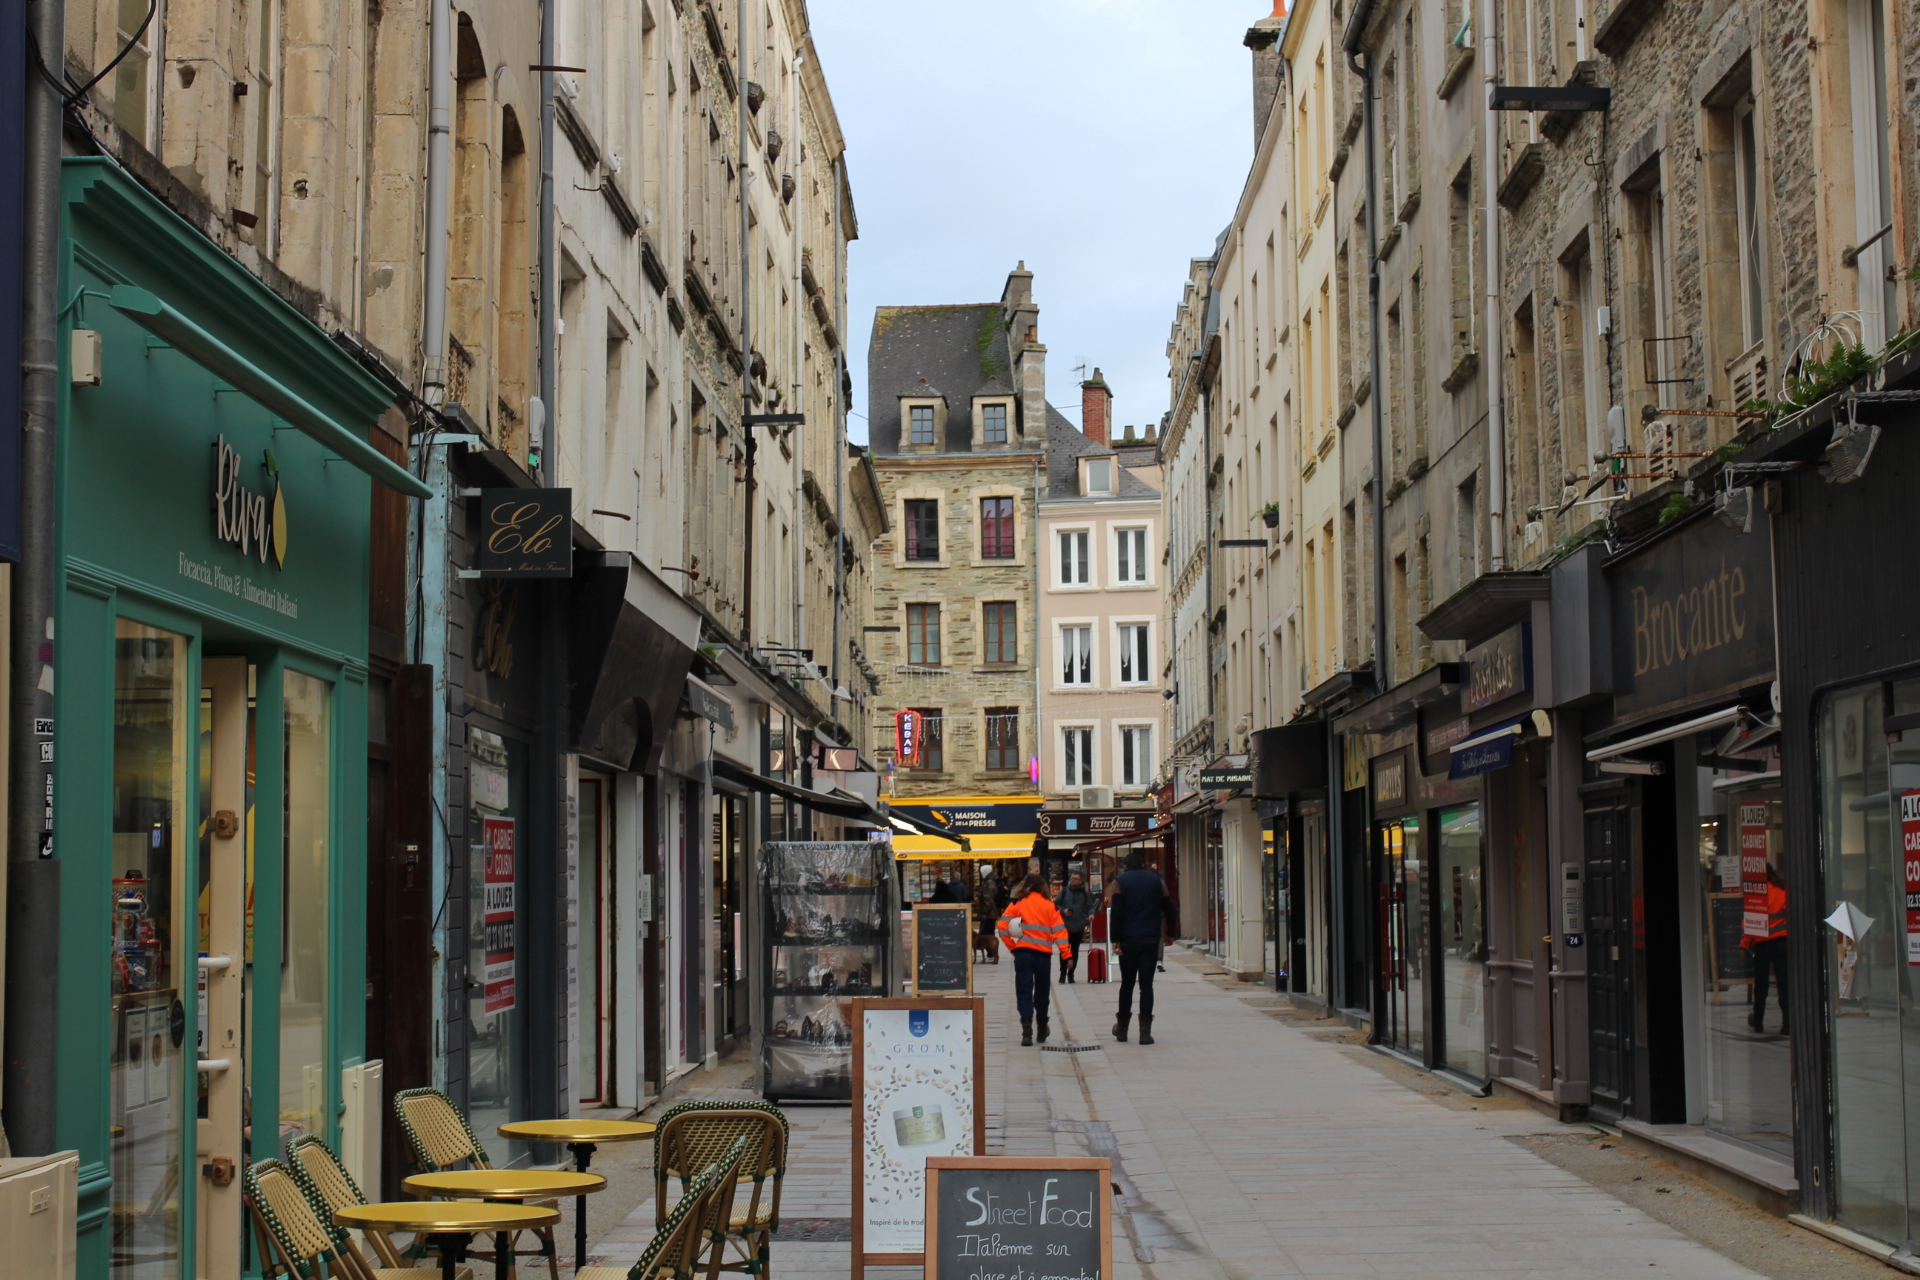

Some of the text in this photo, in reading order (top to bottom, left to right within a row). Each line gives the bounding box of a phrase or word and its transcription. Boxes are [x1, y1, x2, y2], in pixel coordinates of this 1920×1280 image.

[215, 433, 270, 563] Riva
[488, 501, 563, 553] Elo
[178, 551, 298, 619] Focaccia, Pinsa & Alimentari Italiani
[1631, 553, 1746, 677] Brocante
[903, 713, 912, 755] KEBAB
[1226, 774, 1253, 782] MISAINE
[1746, 807, 1766, 824] LOUER
[1902, 799, 1909, 819] A
[1110, 815, 1135, 833] Jean
[493, 828, 514, 850] CABINET
[1742, 834, 1766, 849] CABINET
[494, 853, 513, 875] COUSIN
[1743, 856, 1767, 873] COUSIN
[487, 886, 513, 911] A LOUER
[1569, 936, 1579, 945] 24
[893, 1044, 945, 1053] GROM
[965, 1178, 1093, 1229] Street Food
[869, 1218, 892, 1228] Inspiré
[892, 1218, 902, 1226] de
[902, 1218, 910, 1226] la
[1045, 1242, 1072, 1256] sur
